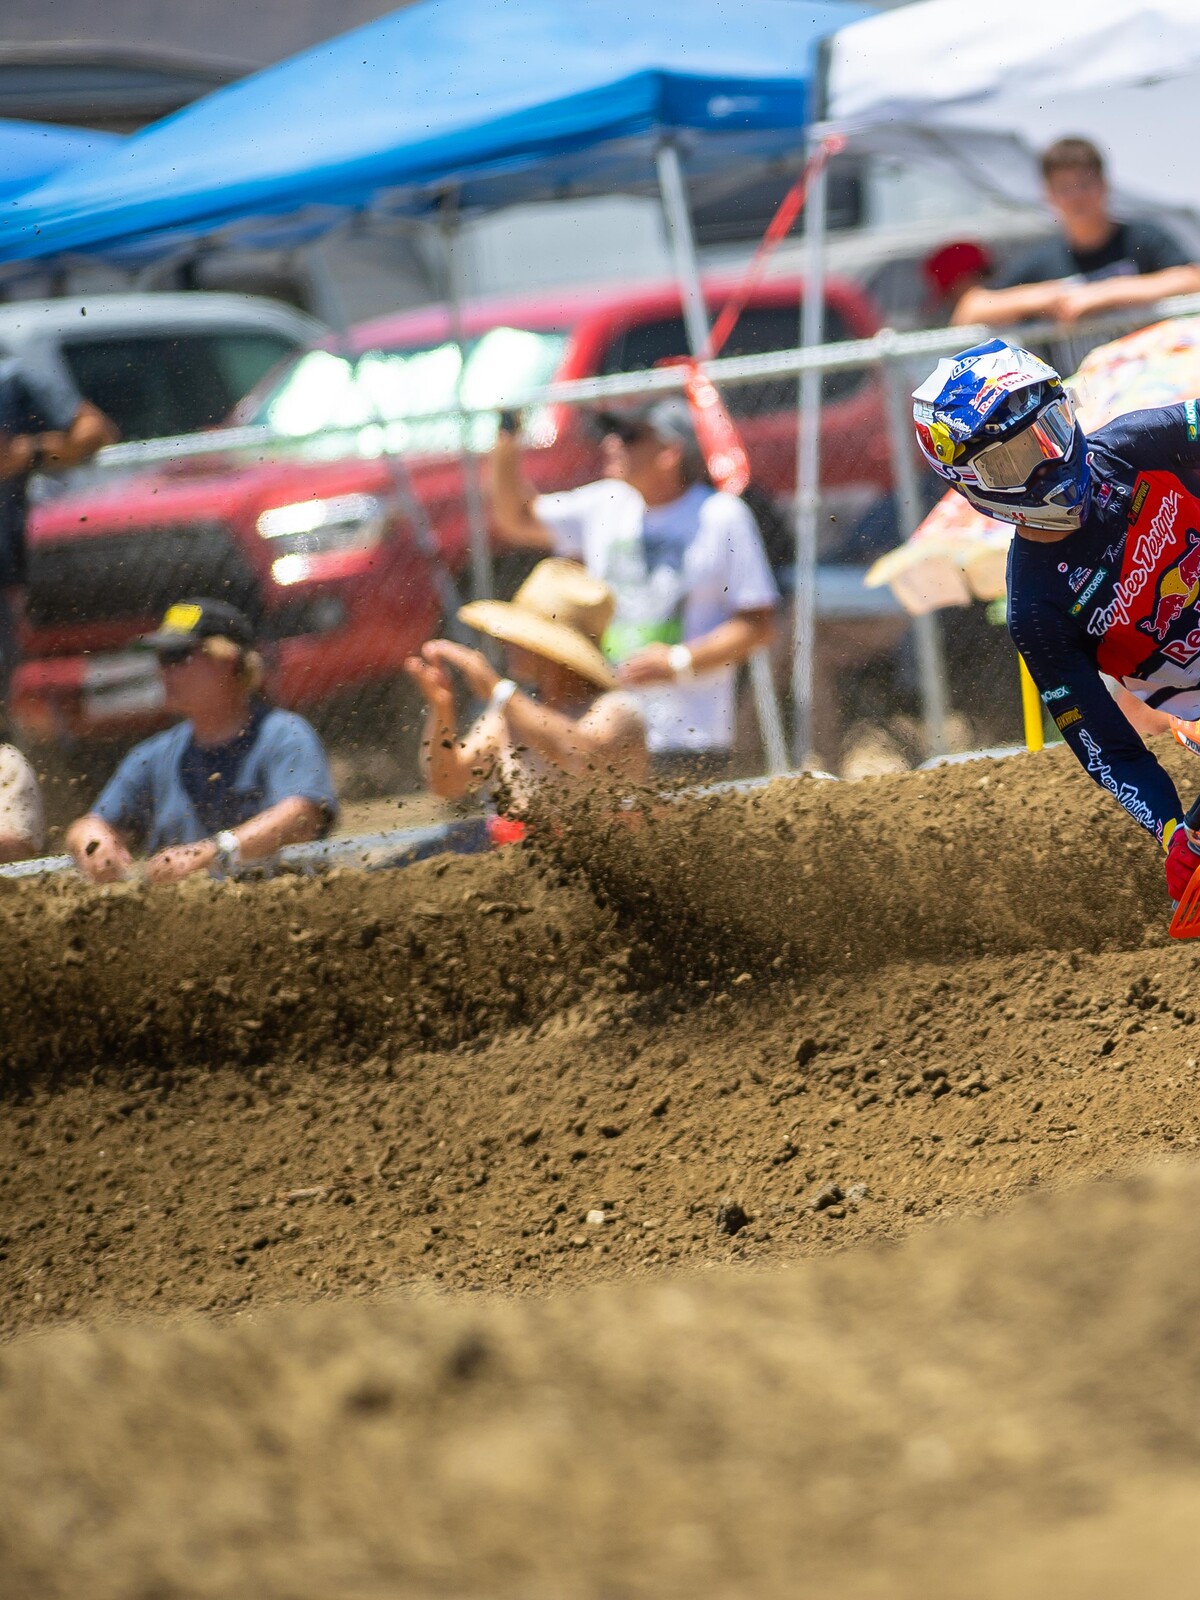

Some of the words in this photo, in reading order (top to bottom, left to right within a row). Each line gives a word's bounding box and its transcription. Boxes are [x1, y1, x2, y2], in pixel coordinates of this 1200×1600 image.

[1078, 568, 1107, 605] MOTOREX
[1113, 567, 1147, 607] Lee
[1132, 490, 1179, 572] Designs
